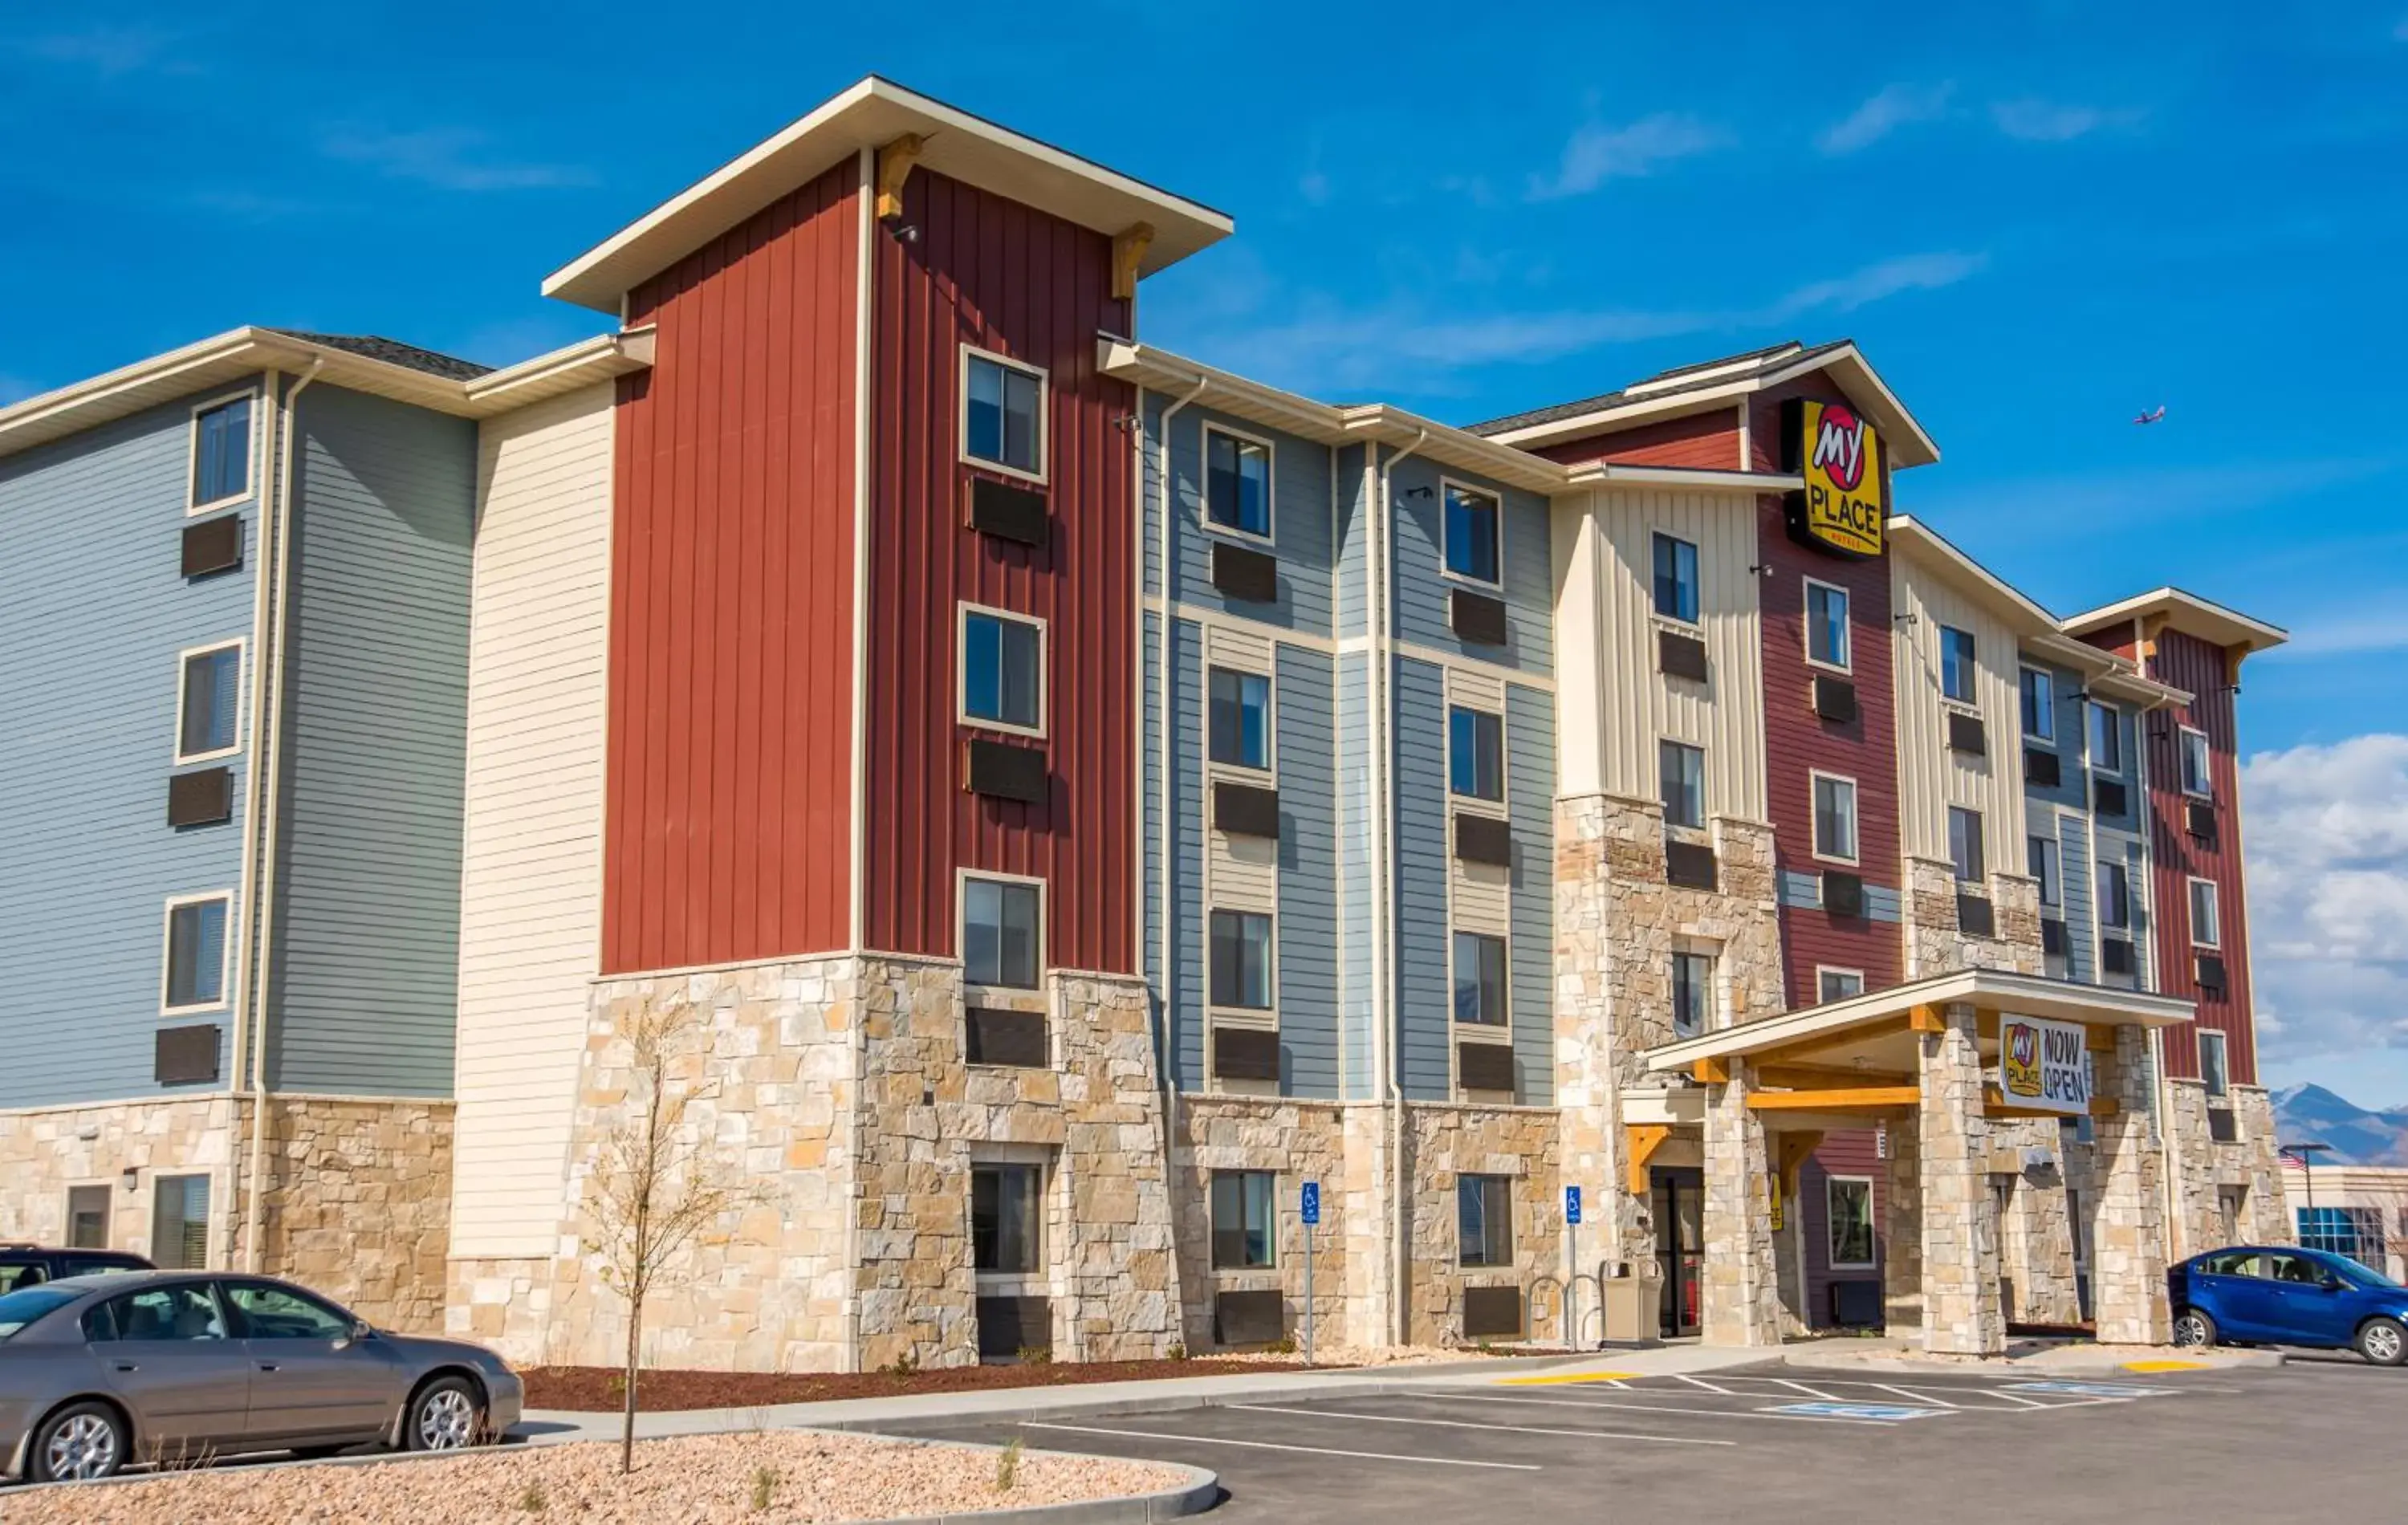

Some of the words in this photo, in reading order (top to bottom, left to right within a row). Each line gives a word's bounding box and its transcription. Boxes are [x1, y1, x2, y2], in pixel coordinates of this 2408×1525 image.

[1811, 484, 1877, 536] PLACE
[2045, 1028, 2080, 1066] NOW
[2044, 1068, 2085, 1103] OPEN
